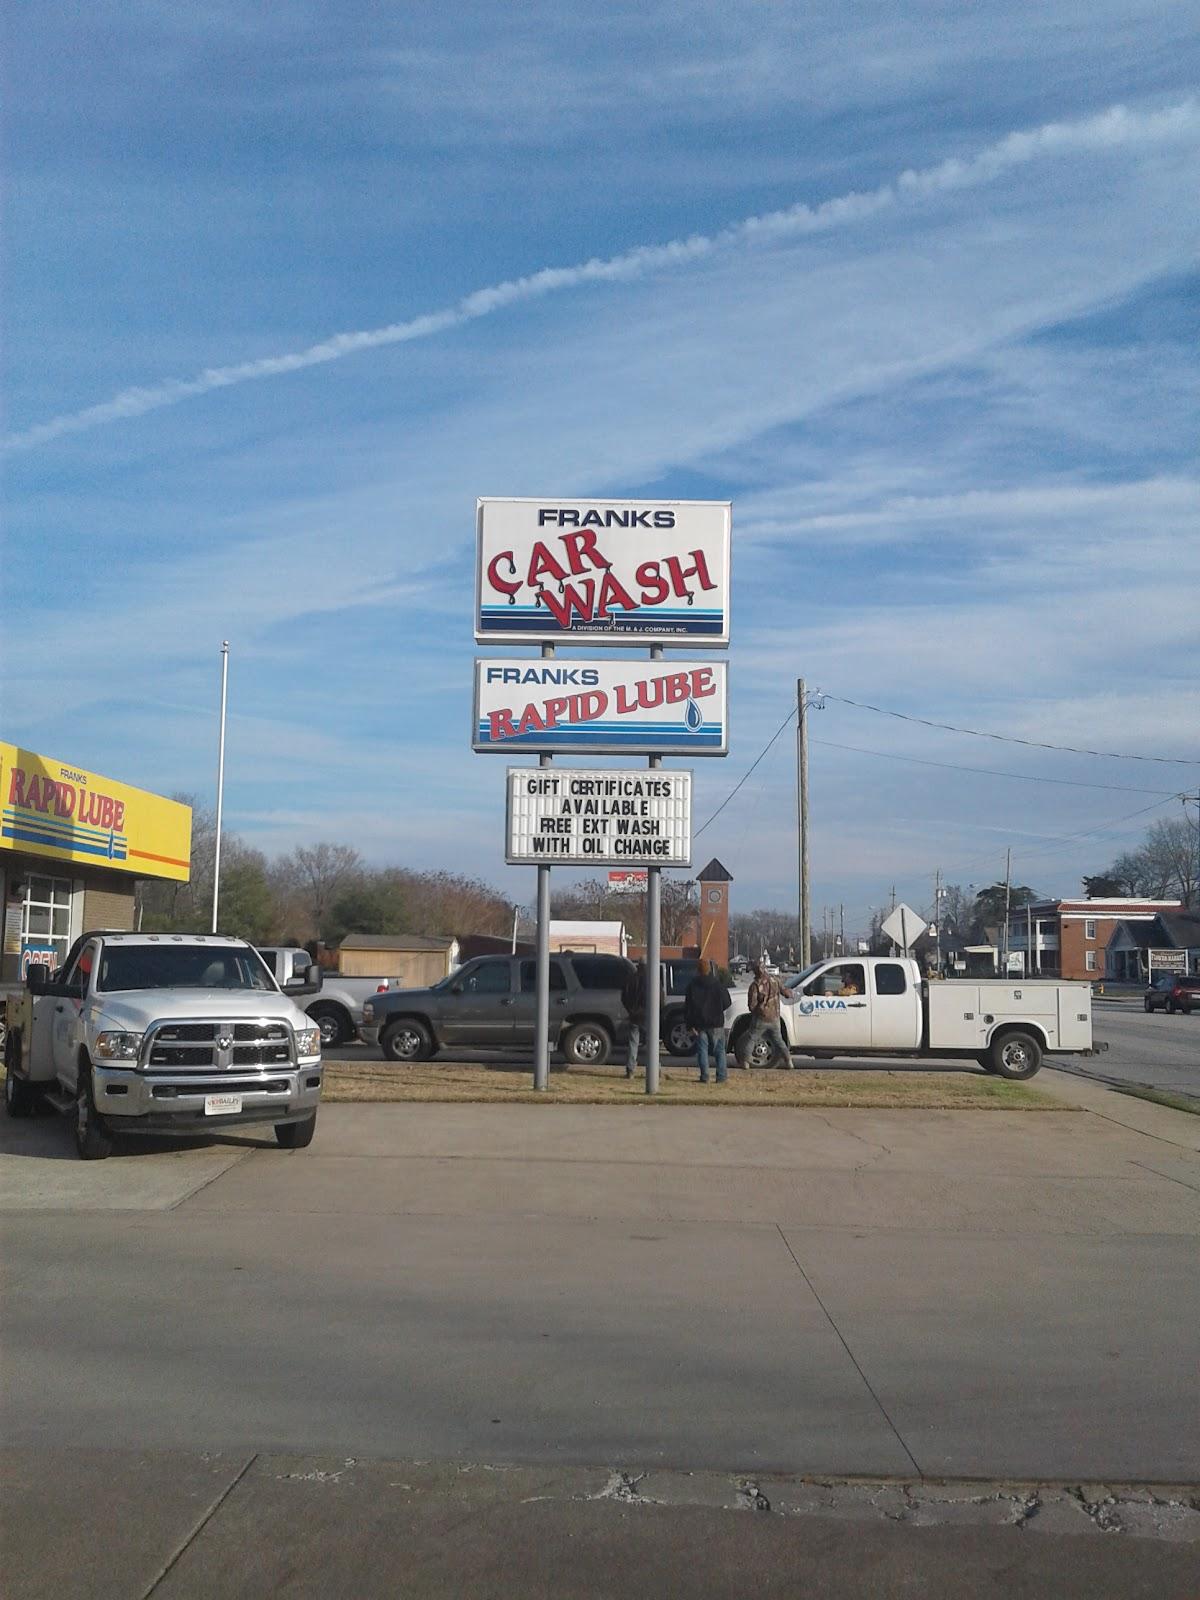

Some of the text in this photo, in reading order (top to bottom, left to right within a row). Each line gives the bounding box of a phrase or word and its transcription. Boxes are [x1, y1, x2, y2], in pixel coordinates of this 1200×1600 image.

[538, 509, 675, 528] FRANKS
[487, 529, 613, 597] CAR
[535, 549, 718, 628] WASH
[487, 667, 599, 685] FRANKS
[487, 667, 717, 741] RAPID LUBE
[60, 768, 87, 785] FRANKS
[527, 779, 671, 797] GIFT CERTIFICATES
[8, 767, 125, 832] RAPID LUBE
[562, 799, 648, 816] AVAILABLE
[540, 818, 660, 835] FREE EXT WASH
[533, 837, 670, 855] WITH OIL CHANGE
[815, 1000, 847, 1009] KVA
